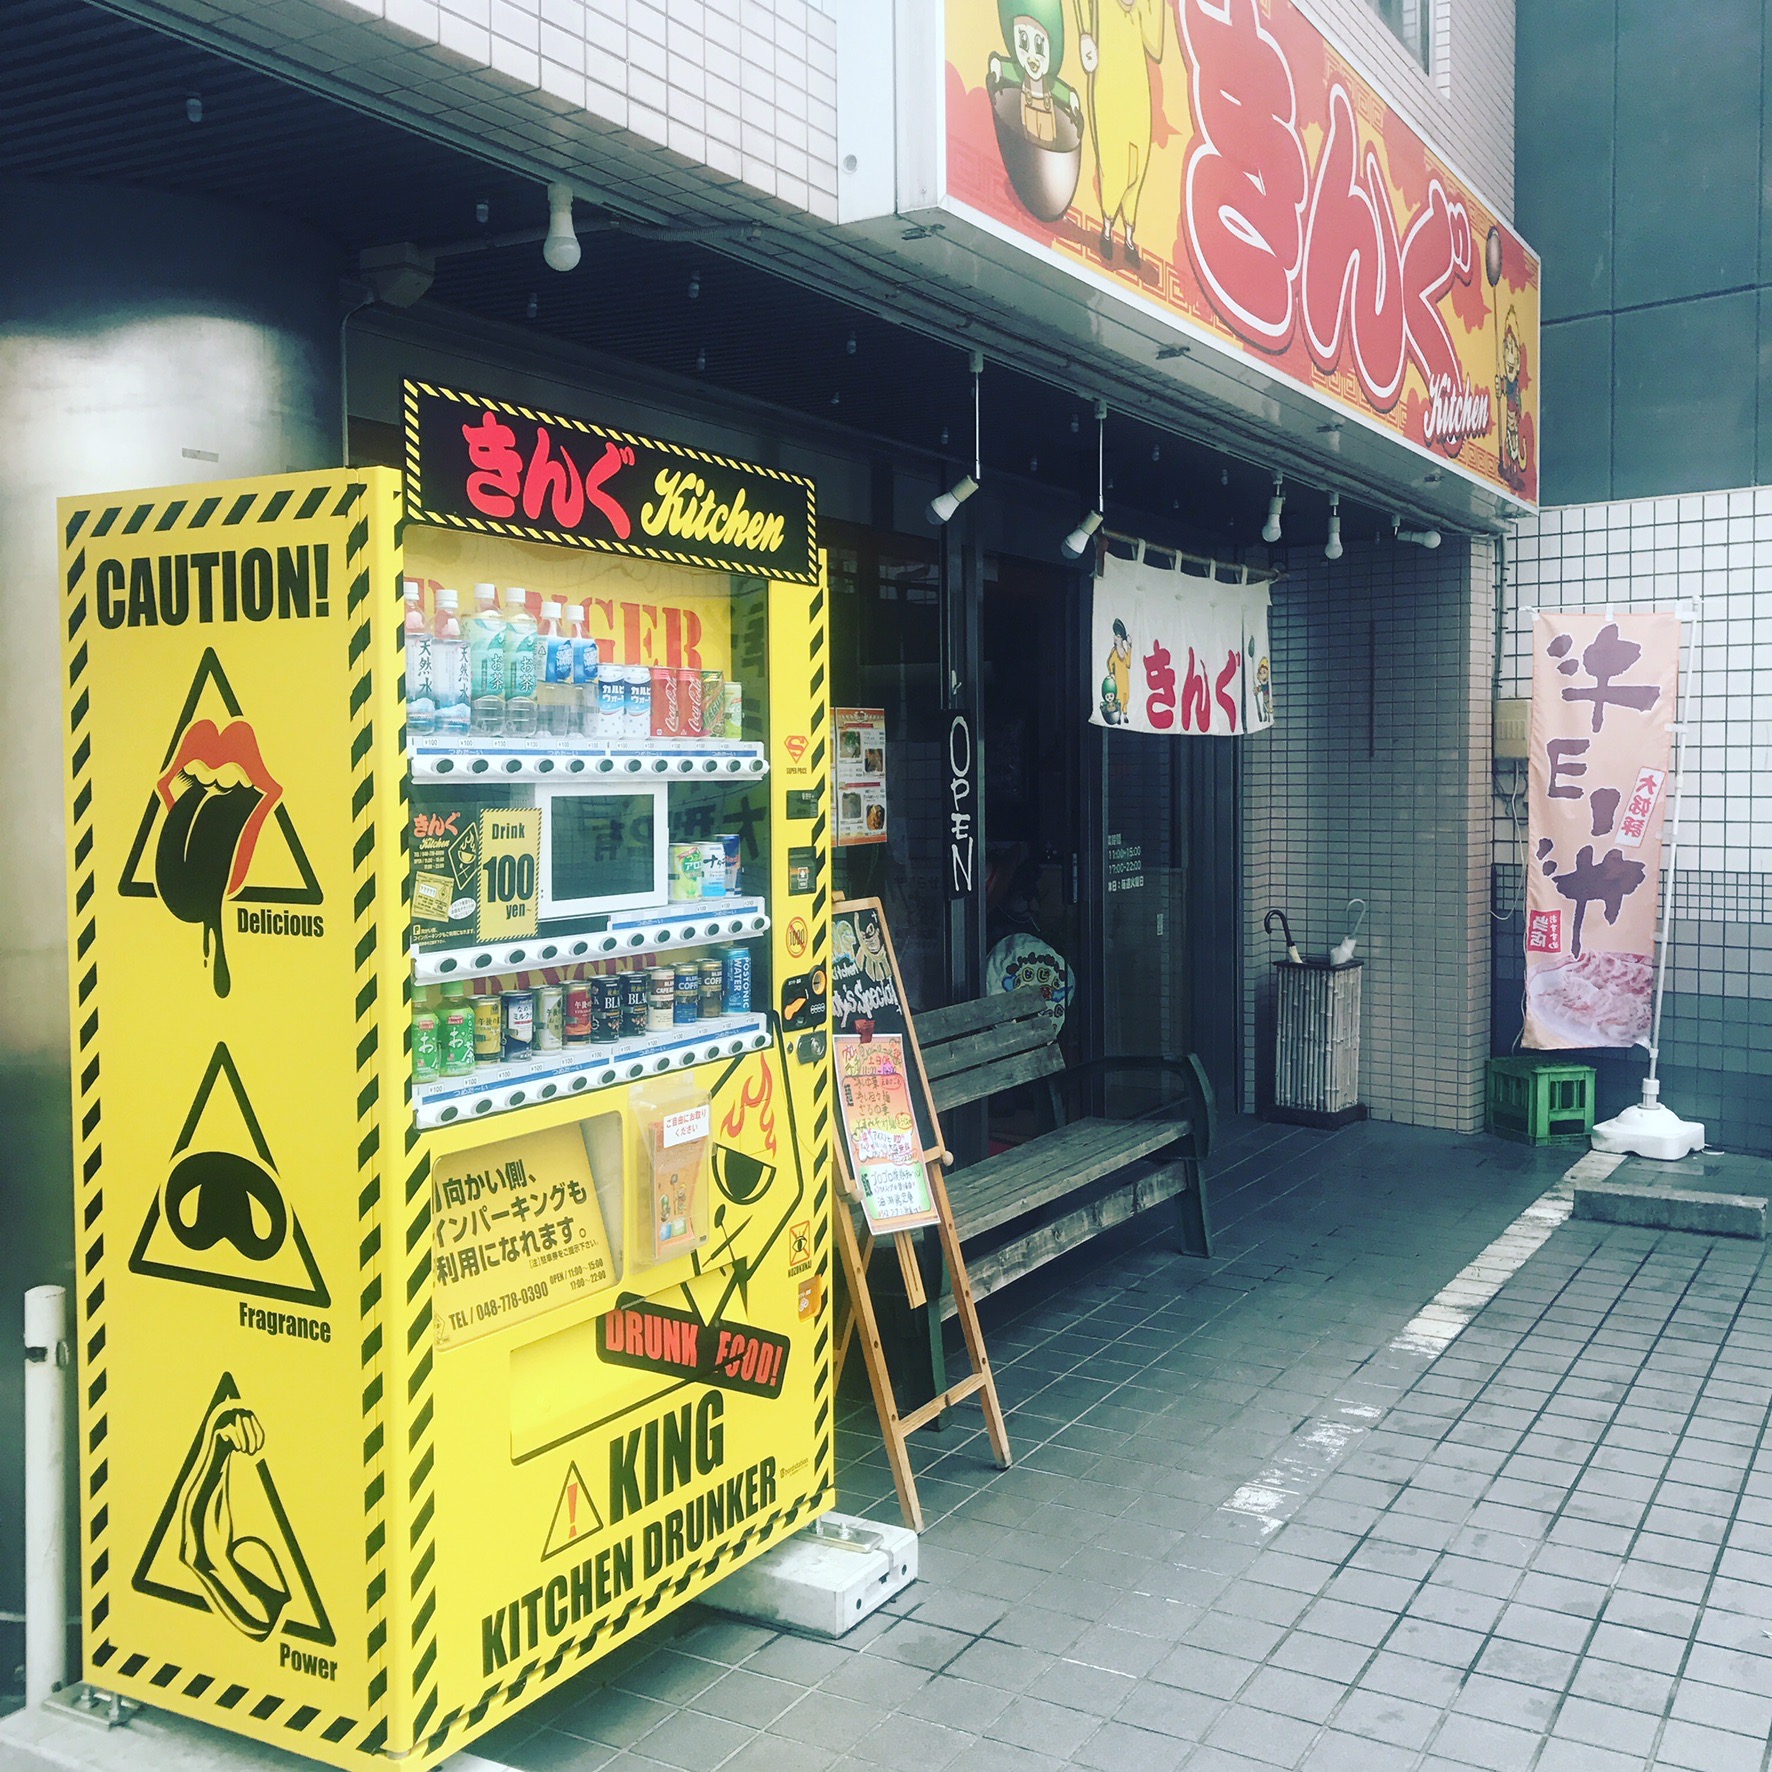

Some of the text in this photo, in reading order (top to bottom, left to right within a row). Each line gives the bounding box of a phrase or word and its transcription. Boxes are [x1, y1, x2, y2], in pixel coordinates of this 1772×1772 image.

[1183, 0, 1473, 413] きんぐ
[1424, 371, 1490, 441] Kitchen
[462, 411, 785, 552] きんぐ Kitchen
[97, 544, 329, 630] CAUTION!
[418, 639, 433, 694] 天然水
[490, 652, 504, 690] お茶
[520, 655, 534, 692] お茶
[1143, 639, 1241, 733] きんぐ
[413, 812, 461, 838] きんぐ
[950, 716, 974, 891] OPEN
[491, 823, 526, 840] Drink
[483, 853, 535, 903] 100
[237, 907, 325, 938] Delicious
[832, 962, 859, 980] itchen
[666, 1109, 706, 1129] ご自由にお取り
[675, 1125, 698, 1137] ください
[239, 1302, 332, 1344] Fragrance
[449, 1309, 469, 1332] TEL
[476, 1281, 549, 1322] 048-778-0390
[605, 1310, 699, 1368] DRUNK
[609, 1390, 724, 1526] KING
[481, 1456, 776, 1678] KITCHEN DRUNKER
[279, 1642, 338, 1682] Power
